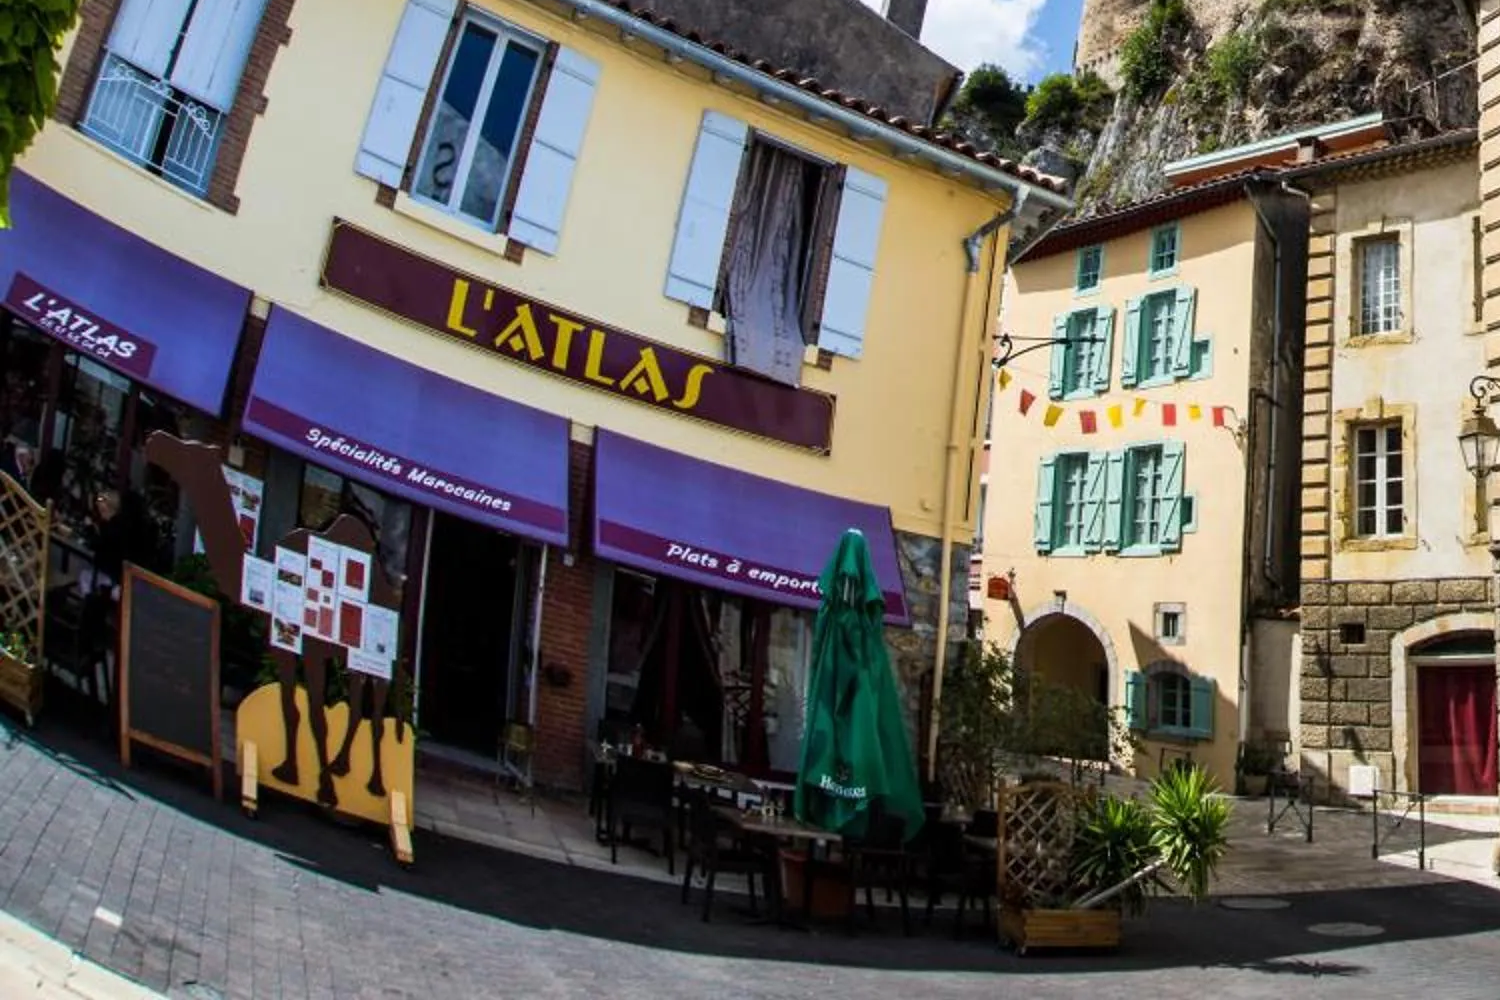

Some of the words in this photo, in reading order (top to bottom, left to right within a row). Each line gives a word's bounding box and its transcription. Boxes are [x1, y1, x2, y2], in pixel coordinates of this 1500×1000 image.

[23, 292, 137, 358] L'ATLAS
[446, 278, 715, 409] L'ATLAS
[306, 428, 401, 475] Spécialités
[407, 467, 512, 512] Marocaines
[667, 543, 718, 569] Plats
[749, 568, 824, 595] emport
